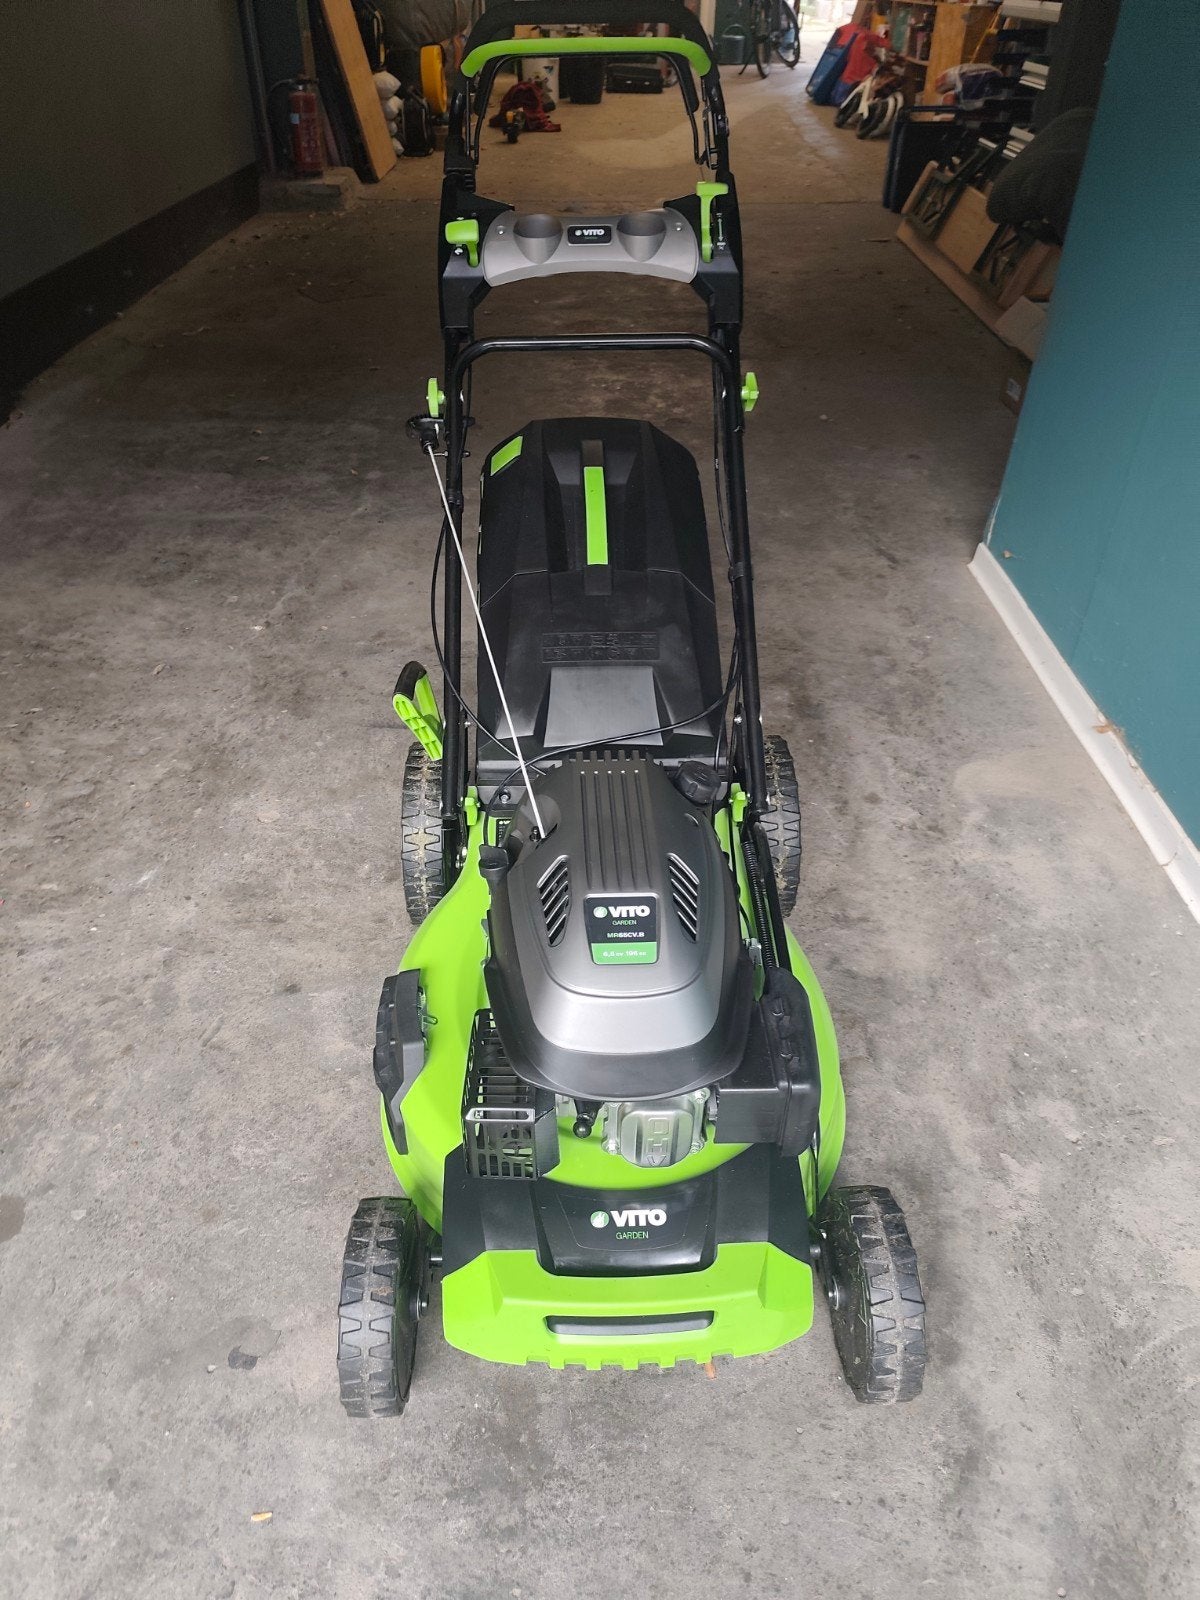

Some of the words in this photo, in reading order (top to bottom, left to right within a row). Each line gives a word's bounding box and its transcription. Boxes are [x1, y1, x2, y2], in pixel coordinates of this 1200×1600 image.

[608, 905, 650, 918] VITO
[610, 1208, 667, 1228] VITO
[616, 1231, 649, 1240] GARDEN
